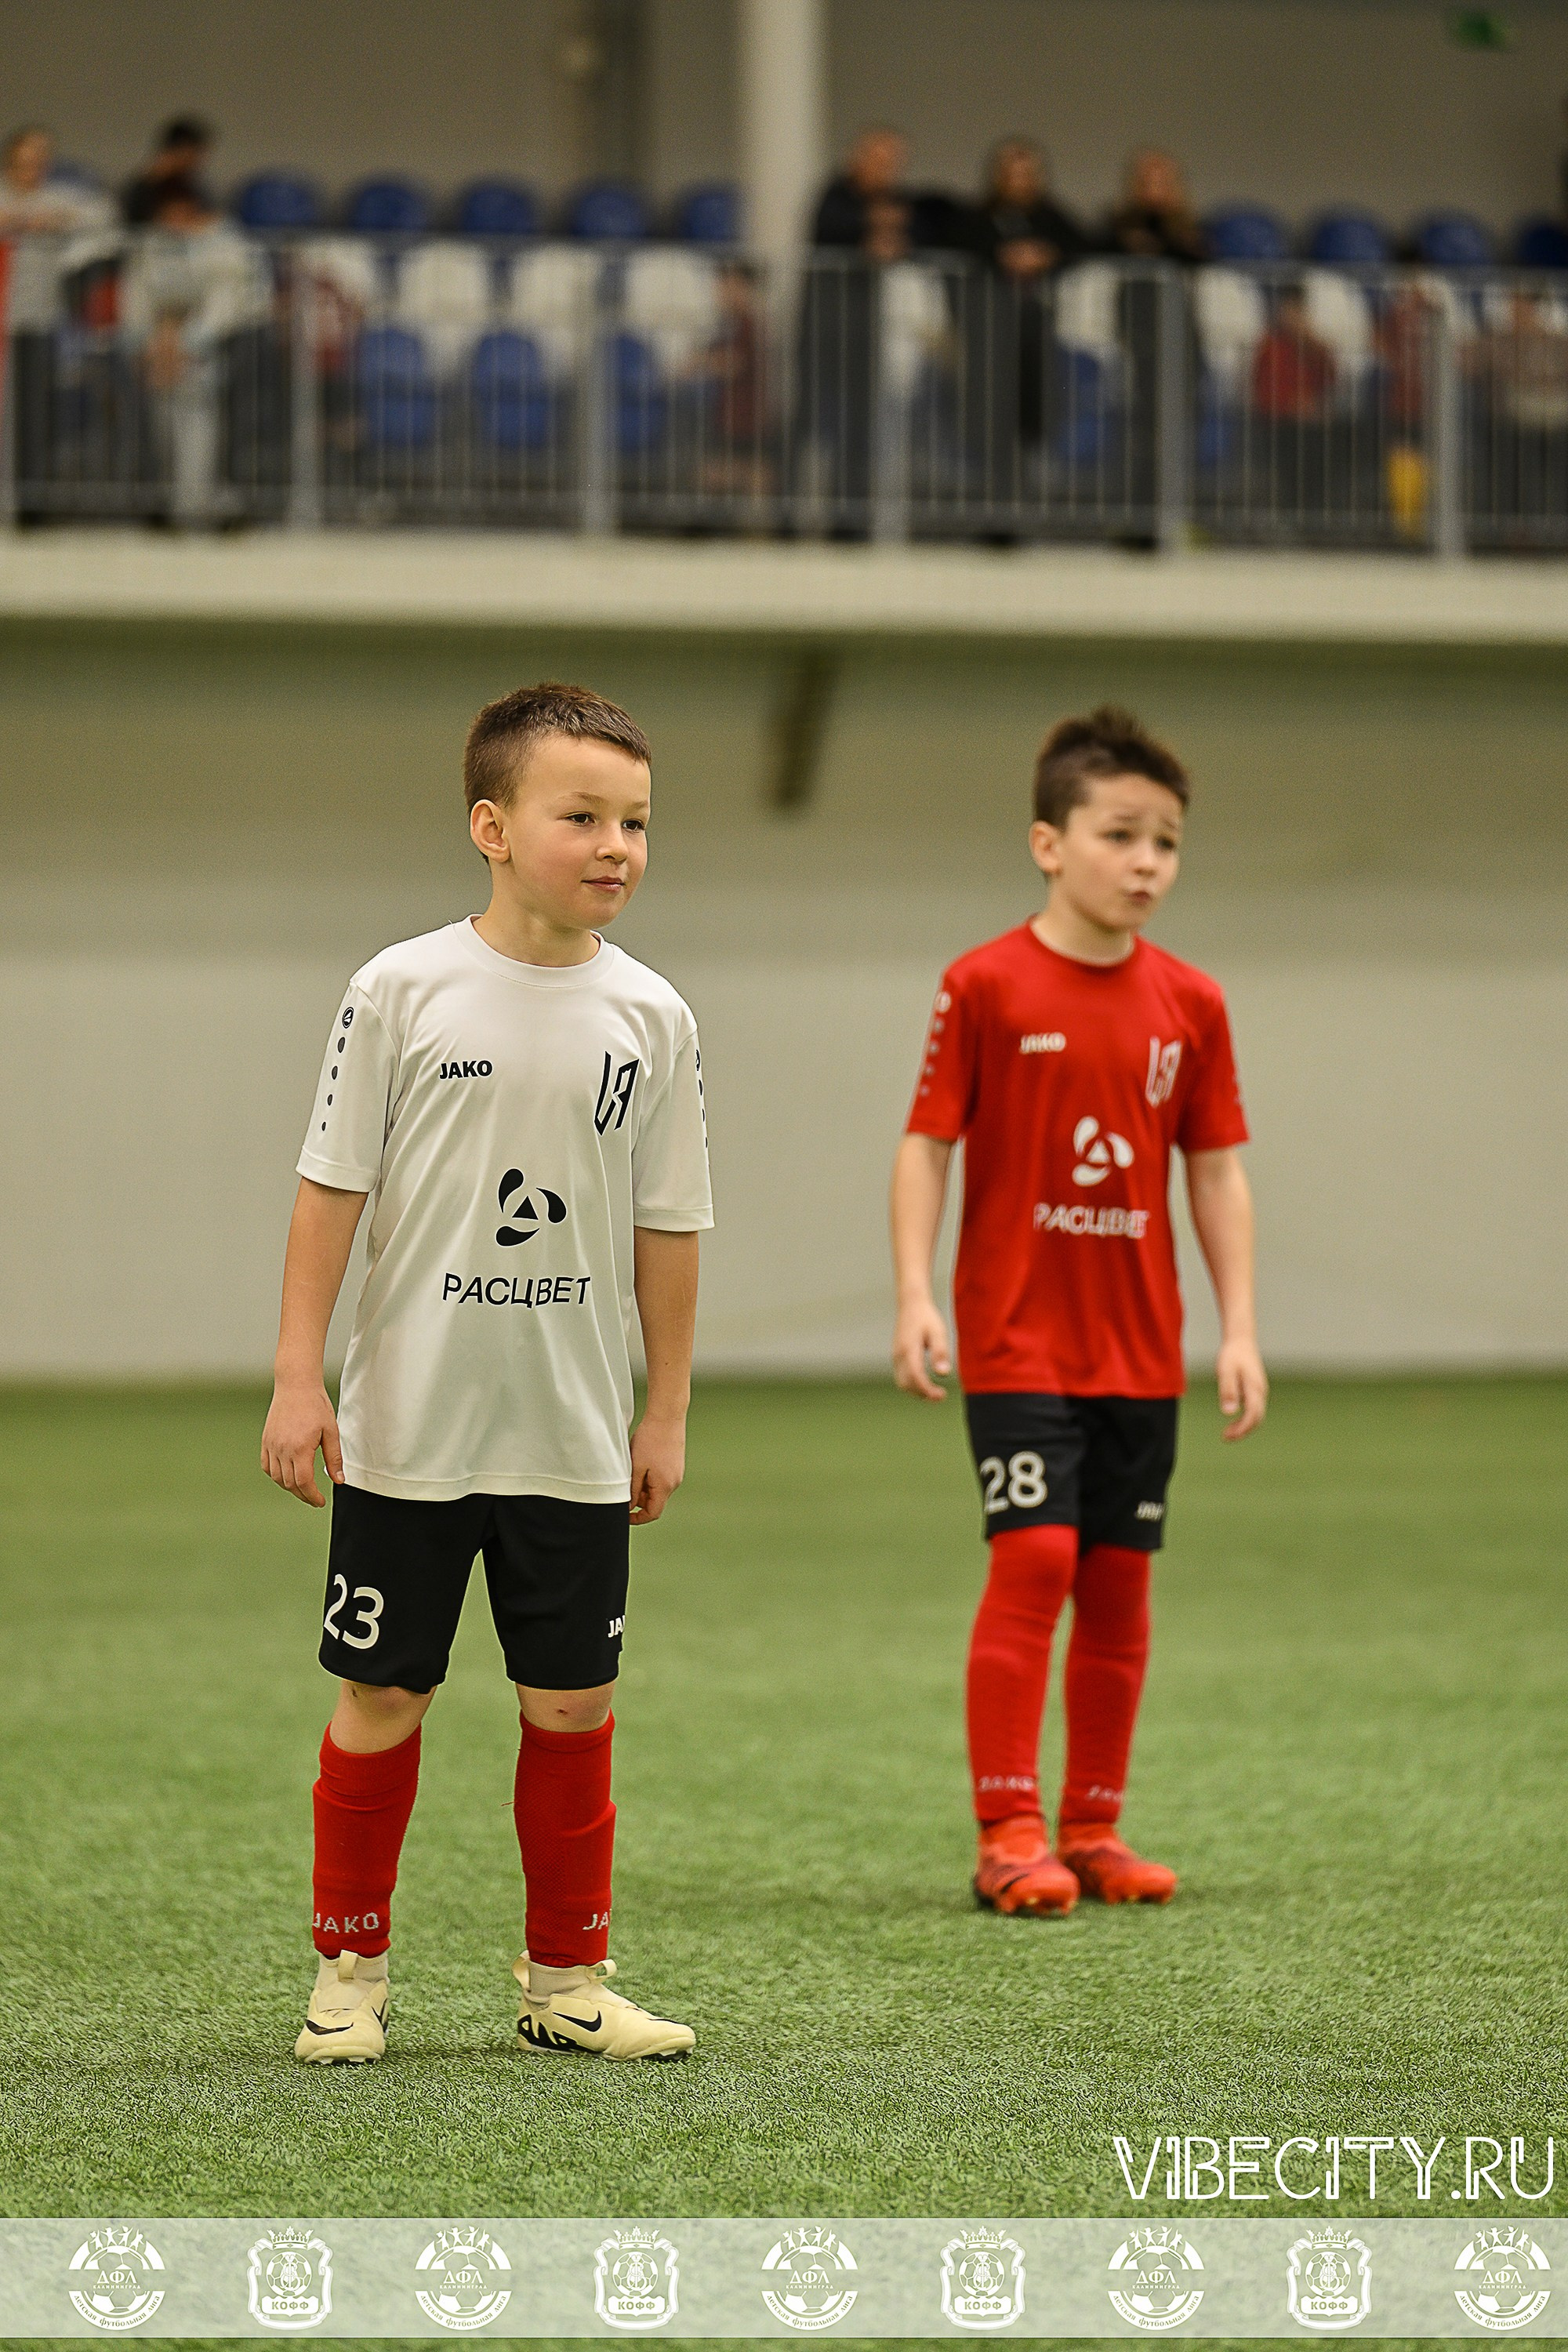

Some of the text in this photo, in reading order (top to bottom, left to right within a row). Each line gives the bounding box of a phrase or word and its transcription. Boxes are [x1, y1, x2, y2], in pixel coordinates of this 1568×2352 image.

[439, 1060, 493, 1080] JAKO
[442, 1272, 591, 1309] РАСЦВЕТ
[980, 1450, 1048, 1515] 28
[322, 1573, 384, 1650] 23
[608, 1615, 625, 1638] JA
[312, 1911, 379, 1933] JAKO
